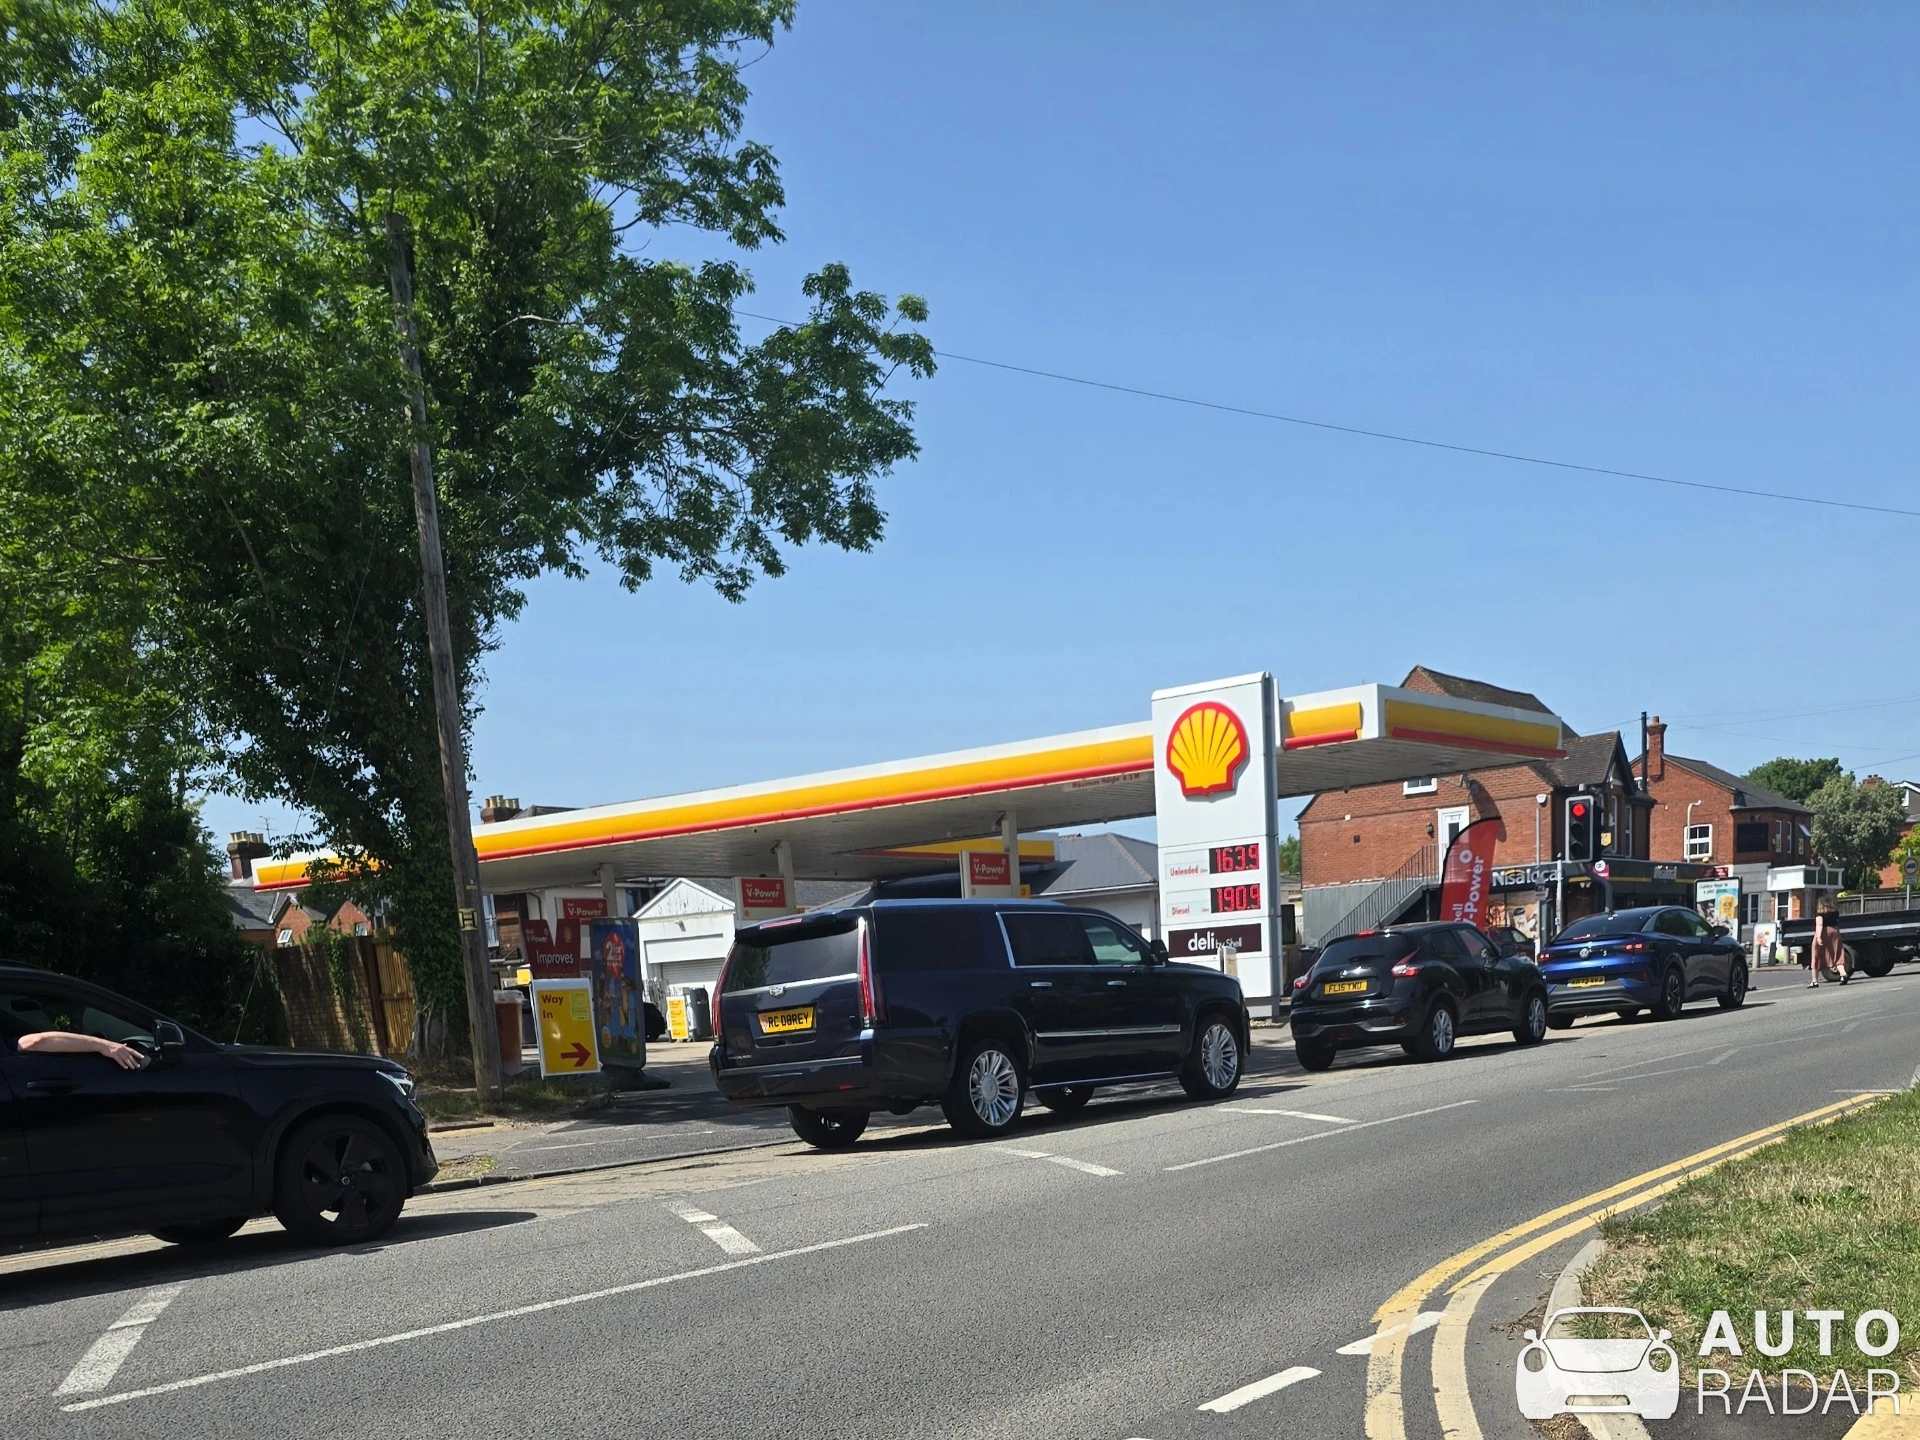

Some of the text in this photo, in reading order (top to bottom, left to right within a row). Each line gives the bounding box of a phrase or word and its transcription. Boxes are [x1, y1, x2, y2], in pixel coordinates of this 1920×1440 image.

[1215, 845, 1259, 872] 163.9
[974, 864, 1005, 874] V-Power
[1170, 865, 1199, 876] Unleaded
[746, 888, 779, 898] V-Power
[1217, 885, 1260, 912] 190.9
[567, 907, 602, 916] V-Power
[1172, 905, 1190, 915] Diesel
[1188, 931, 1215, 951] deli
[536, 949, 574, 968] Improves
[541, 994, 564, 1006] Way
[542, 1010, 553, 1019] In
